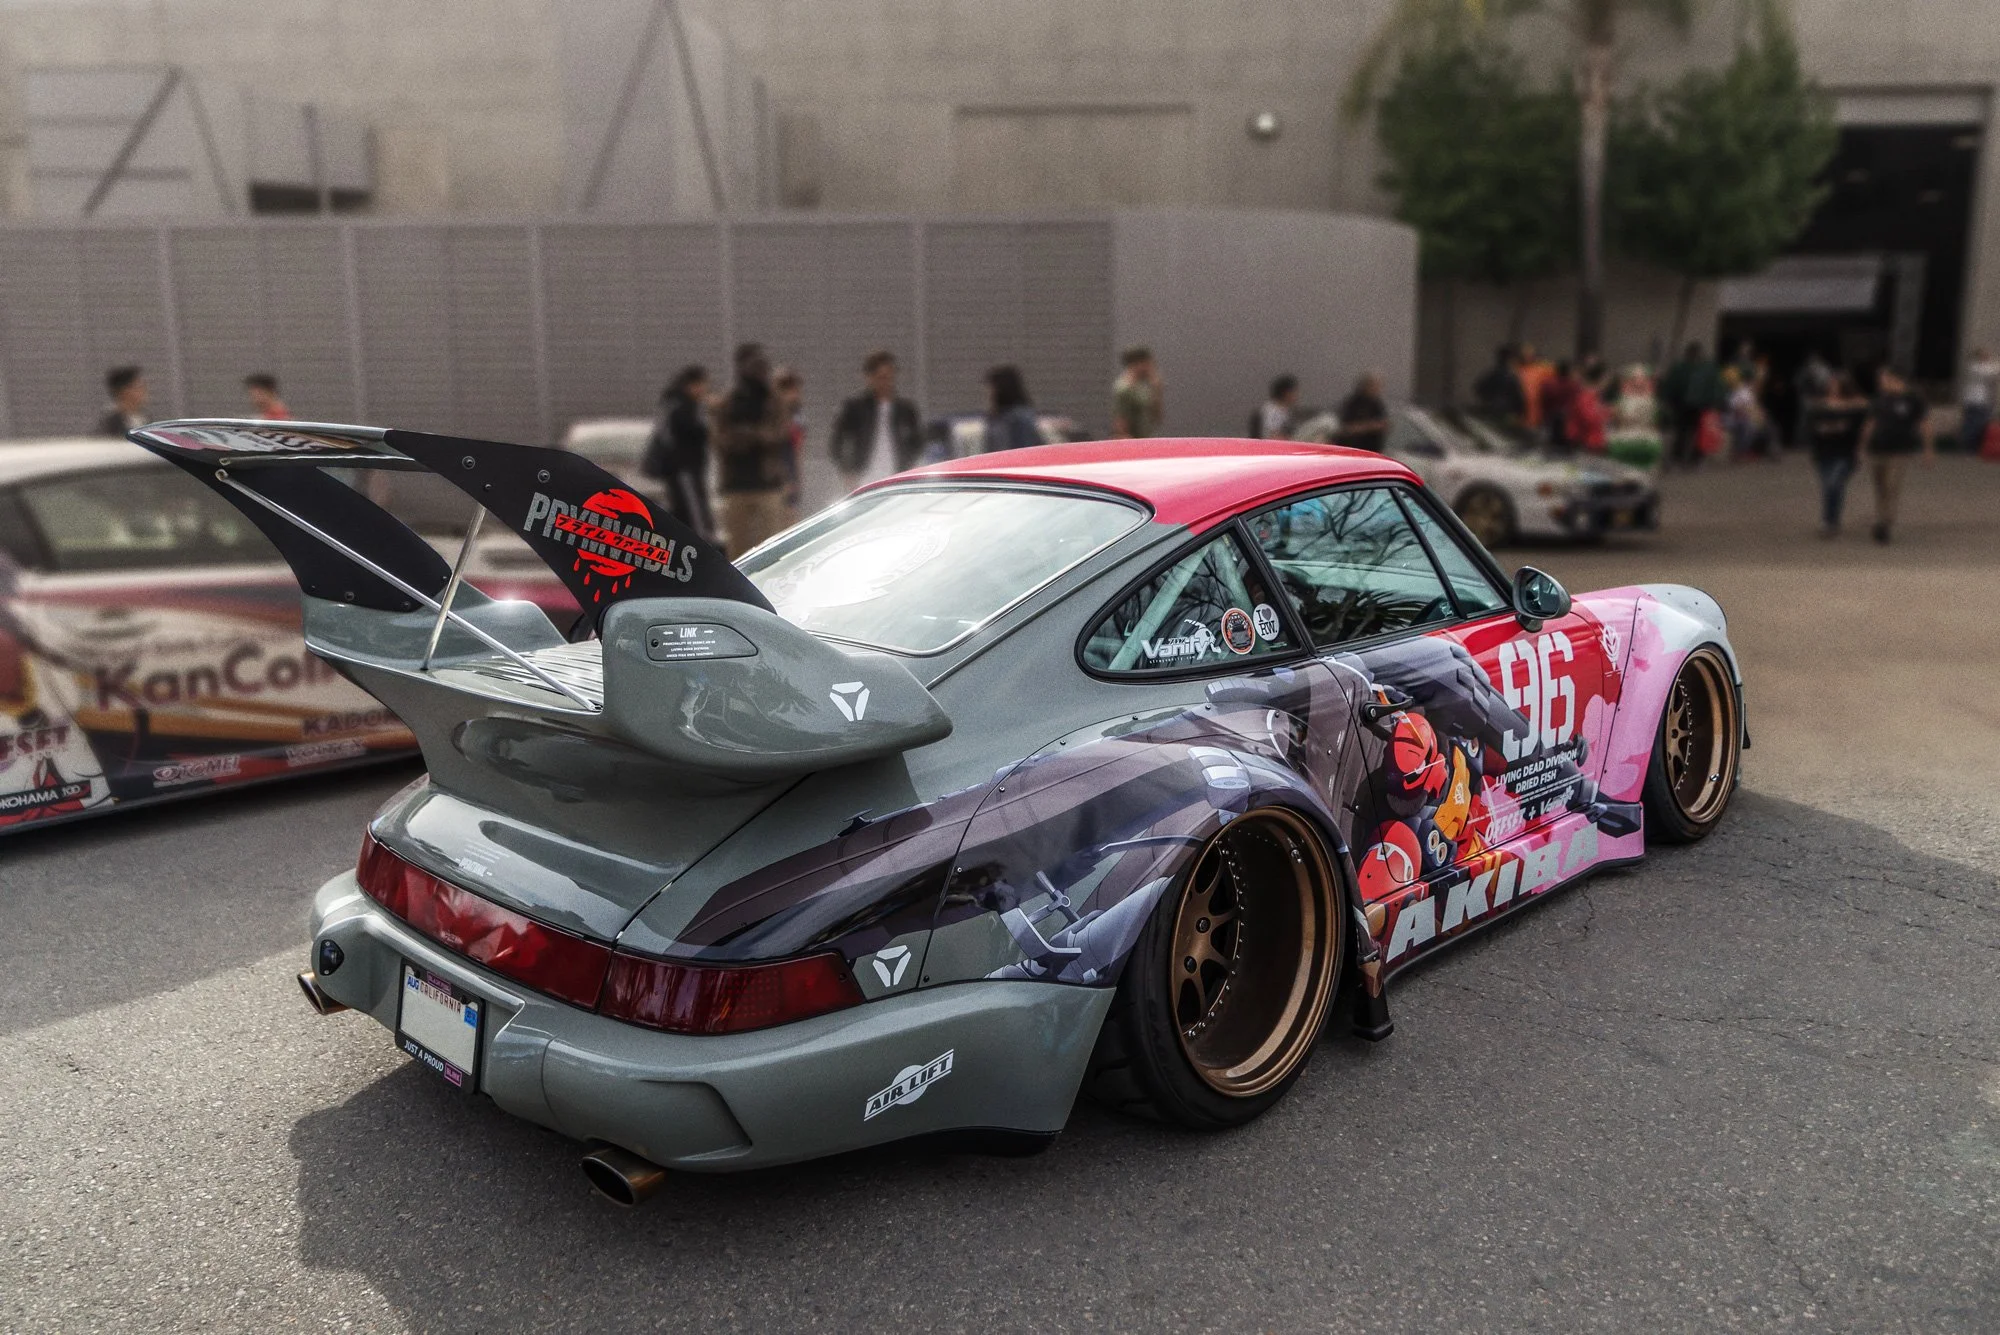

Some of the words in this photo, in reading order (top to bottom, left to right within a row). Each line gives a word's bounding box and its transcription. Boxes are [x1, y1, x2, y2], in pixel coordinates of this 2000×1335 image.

[680, 627, 698, 638] LINK
[1498, 630, 1576, 763] 96
[1495, 768, 1522, 786] LIVING
[1523, 760, 1544, 780] DEAD
[1545, 748, 1577, 770] DIVISION
[1515, 777, 1539, 794] DRIED
[1540, 769, 1557, 787] FISH
[1386, 822, 1598, 964] AKIBA
[407, 976, 420, 990] AUG
[420, 981, 461, 1014] CALIFORNIA
[404, 1040, 418, 1055] JUST
[418, 1050, 423, 1059] A
[424, 1052, 444, 1072] PROUD
[869, 1085, 904, 1114] AIR
[909, 1057, 950, 1090] LIFT
